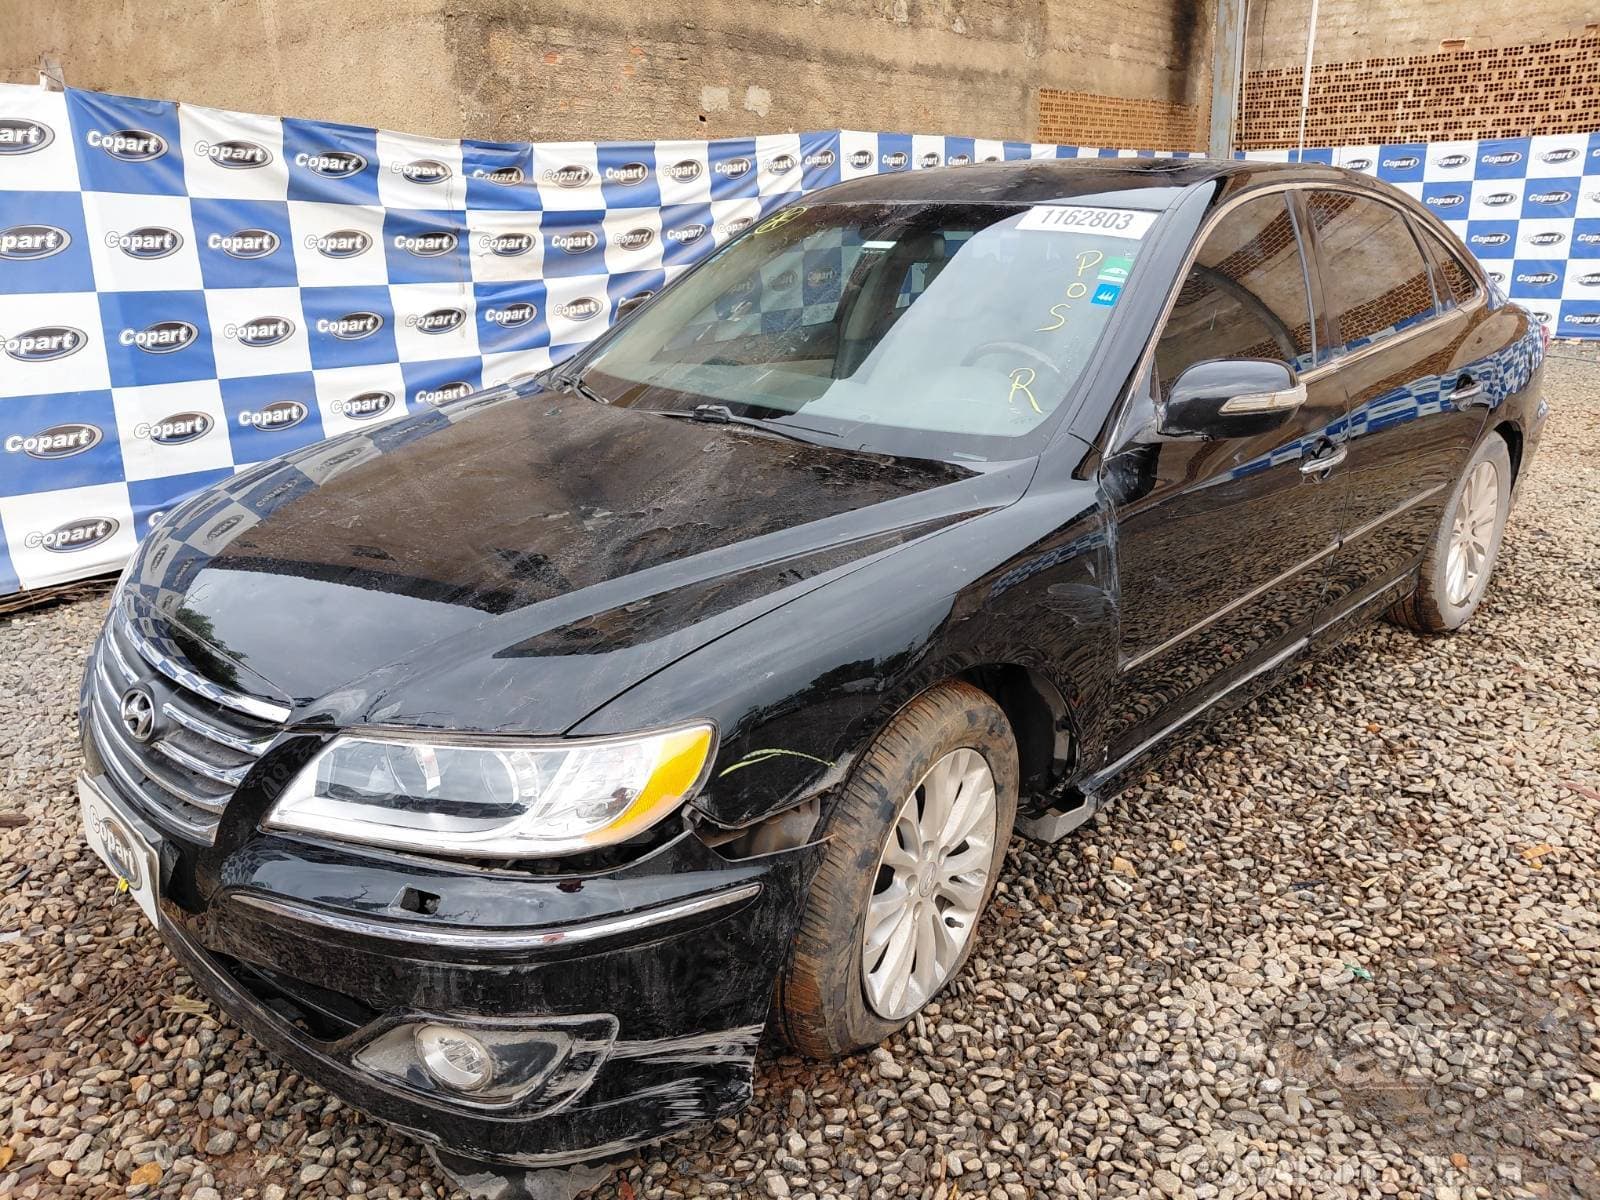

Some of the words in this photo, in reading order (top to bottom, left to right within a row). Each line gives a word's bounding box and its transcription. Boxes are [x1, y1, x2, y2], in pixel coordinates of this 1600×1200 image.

[0, 126, 41, 145] art
[86, 129, 160, 152] Copart
[194, 140, 265, 162] Copart
[805, 152, 833, 165] Copart
[882, 153, 906, 166] Copart
[1481, 153, 1518, 164] Copart
[295, 152, 358, 171] Copart
[391, 161, 446, 176] Copart
[663, 161, 699, 177] Copart
[715, 160, 748, 174] Copart
[763, 157, 793, 170] Copart
[1383, 157, 1416, 168] Copart
[543, 167, 588, 184] Copart
[606, 167, 646, 181] Copart
[1426, 195, 1461, 206] Copart
[1528, 192, 1567, 204] Copart
[1040, 208, 1135, 231] 1162803
[0, 231, 57, 251] part
[104, 230, 175, 250] Copart
[207, 232, 273, 251] Copart
[551, 234, 593, 249] Copart
[614, 231, 651, 246] Copart
[667, 226, 703, 240] Copart
[1470, 233, 1506, 244] Copart
[304, 234, 364, 252] Copart
[393, 234, 451, 252] Copart
[479, 234, 532, 250] Copart
[1516, 273, 1554, 284] Copart
[485, 307, 532, 324] Copart
[553, 300, 597, 317] Copart
[317, 317, 376, 334] Copart
[405, 313, 457, 328] Copart
[119, 324, 191, 347] Copart
[224, 321, 288, 341] Copart
[415, 386, 468, 404] Copart
[1009, 367, 1042, 415] R
[330, 394, 388, 416] Copart
[238, 405, 302, 428] Copart
[134, 415, 206, 441] Copart
[5, 426, 92, 454] Copart
[24, 518, 109, 551] Copart
[90, 804, 136, 876] Copart
